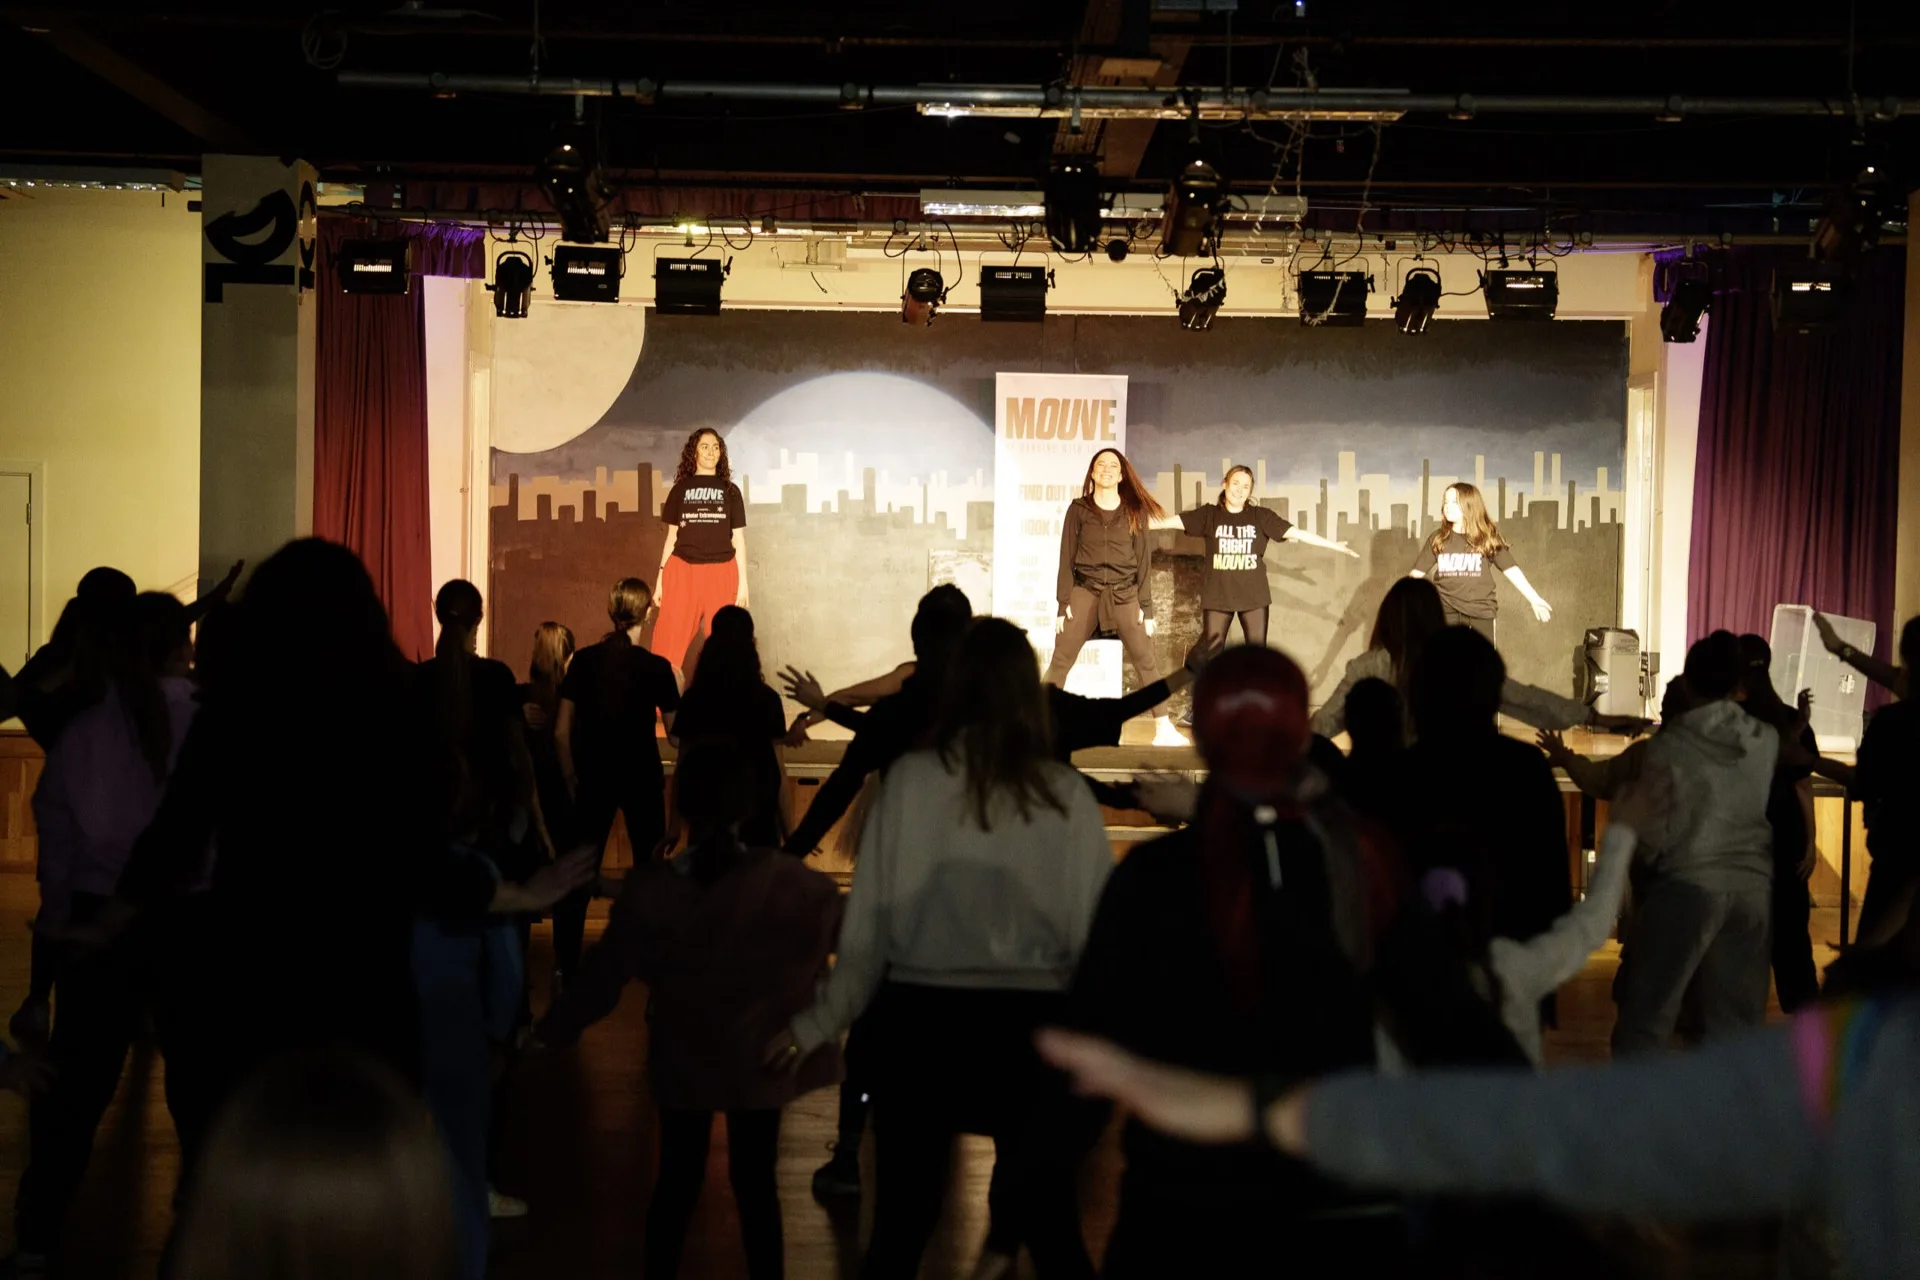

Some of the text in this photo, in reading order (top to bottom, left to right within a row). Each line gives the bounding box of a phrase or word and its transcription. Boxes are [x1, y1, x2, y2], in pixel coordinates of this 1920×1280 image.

[1005, 397, 1117, 441] MOUVE
[684, 488, 724, 500] MOUVE
[1045, 484, 1066, 501] OUT
[1215, 525, 1256, 538] ALL THE
[1219, 538, 1253, 554] RIGHT
[1213, 554, 1258, 570] MOUVES
[1438, 553, 1482, 572] MOUVE
